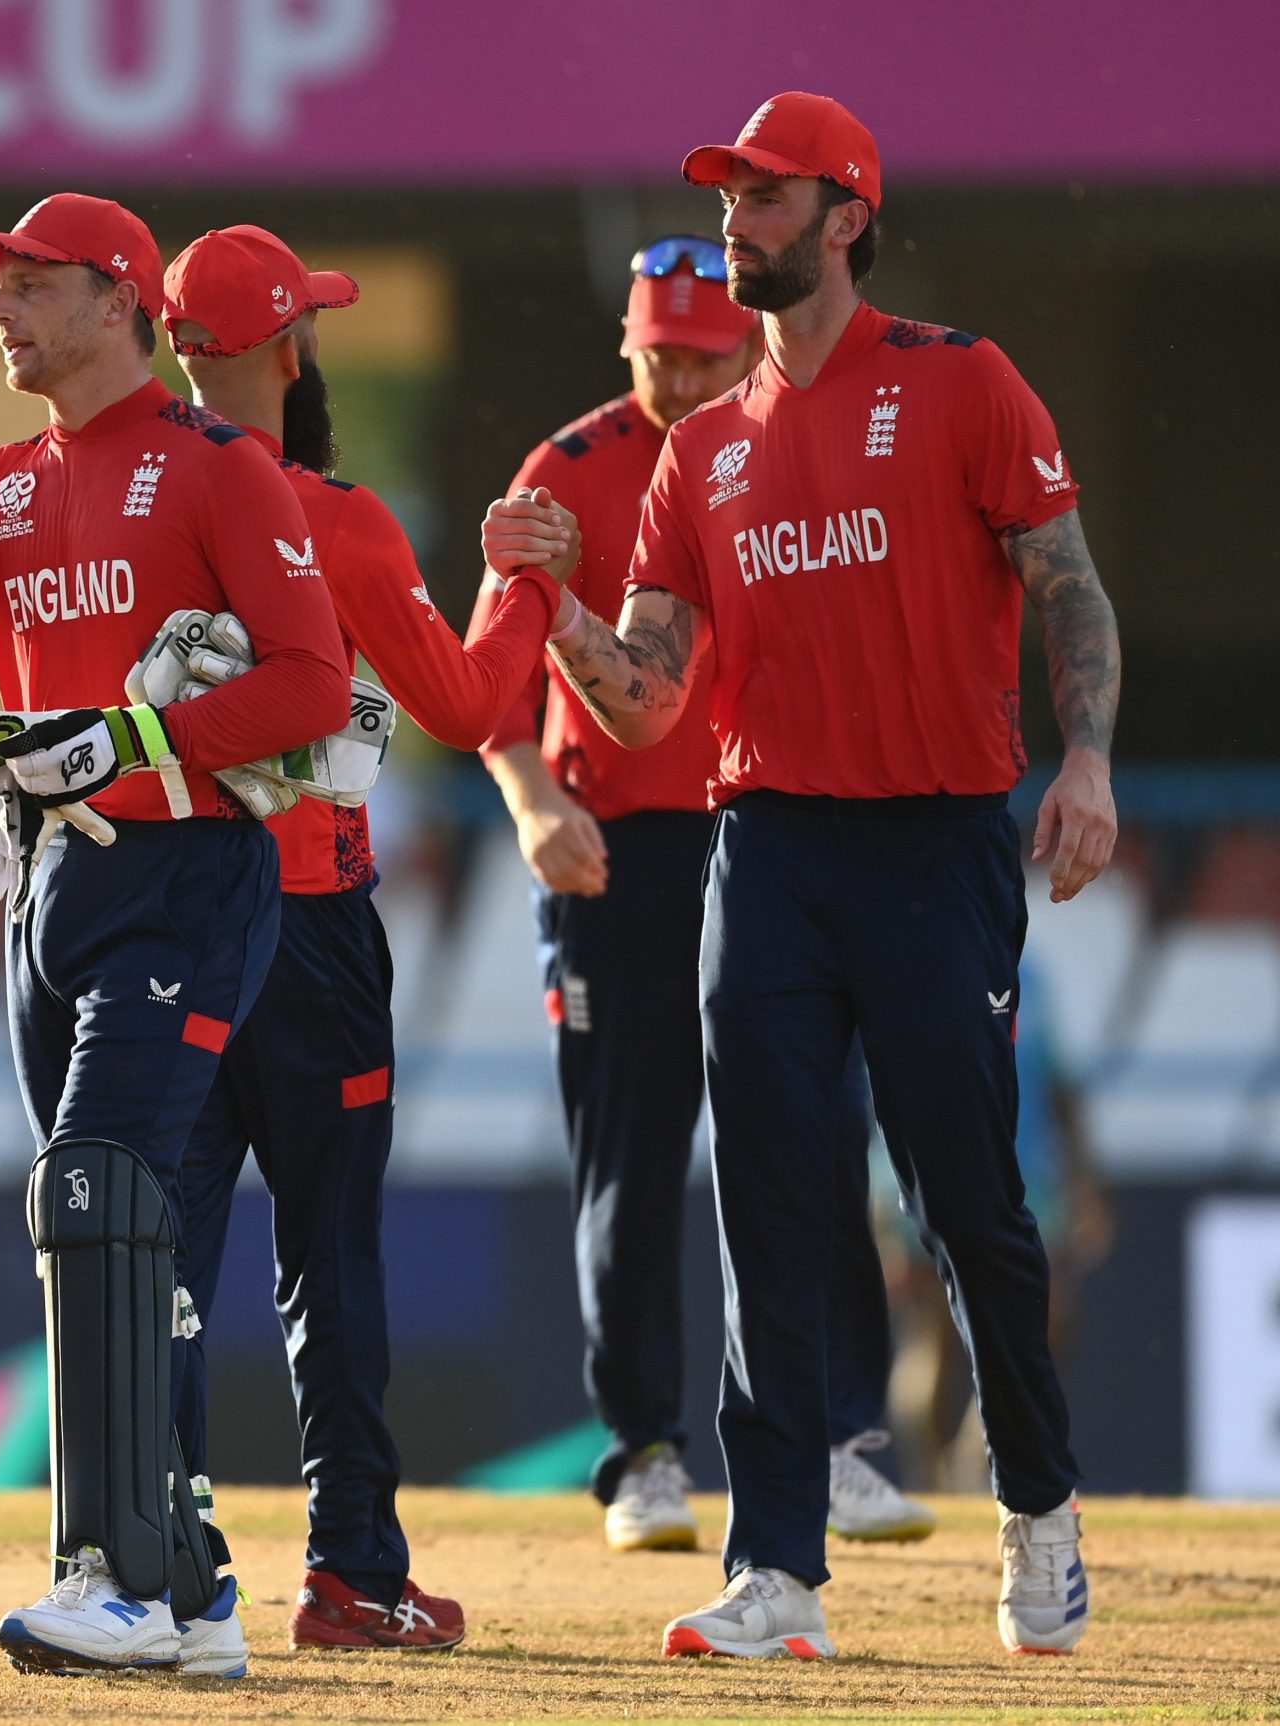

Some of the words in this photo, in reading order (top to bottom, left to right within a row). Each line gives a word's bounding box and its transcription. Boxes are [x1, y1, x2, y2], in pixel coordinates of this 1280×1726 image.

[846, 162, 861, 180] 74
[111, 254, 129, 271] 54
[271, 285, 284, 300] 50
[708, 488, 732, 505] WORLD
[733, 480, 749, 492] CUP
[733, 507, 888, 586] ENGLAND
[4, 559, 135, 633] ENGLAND
